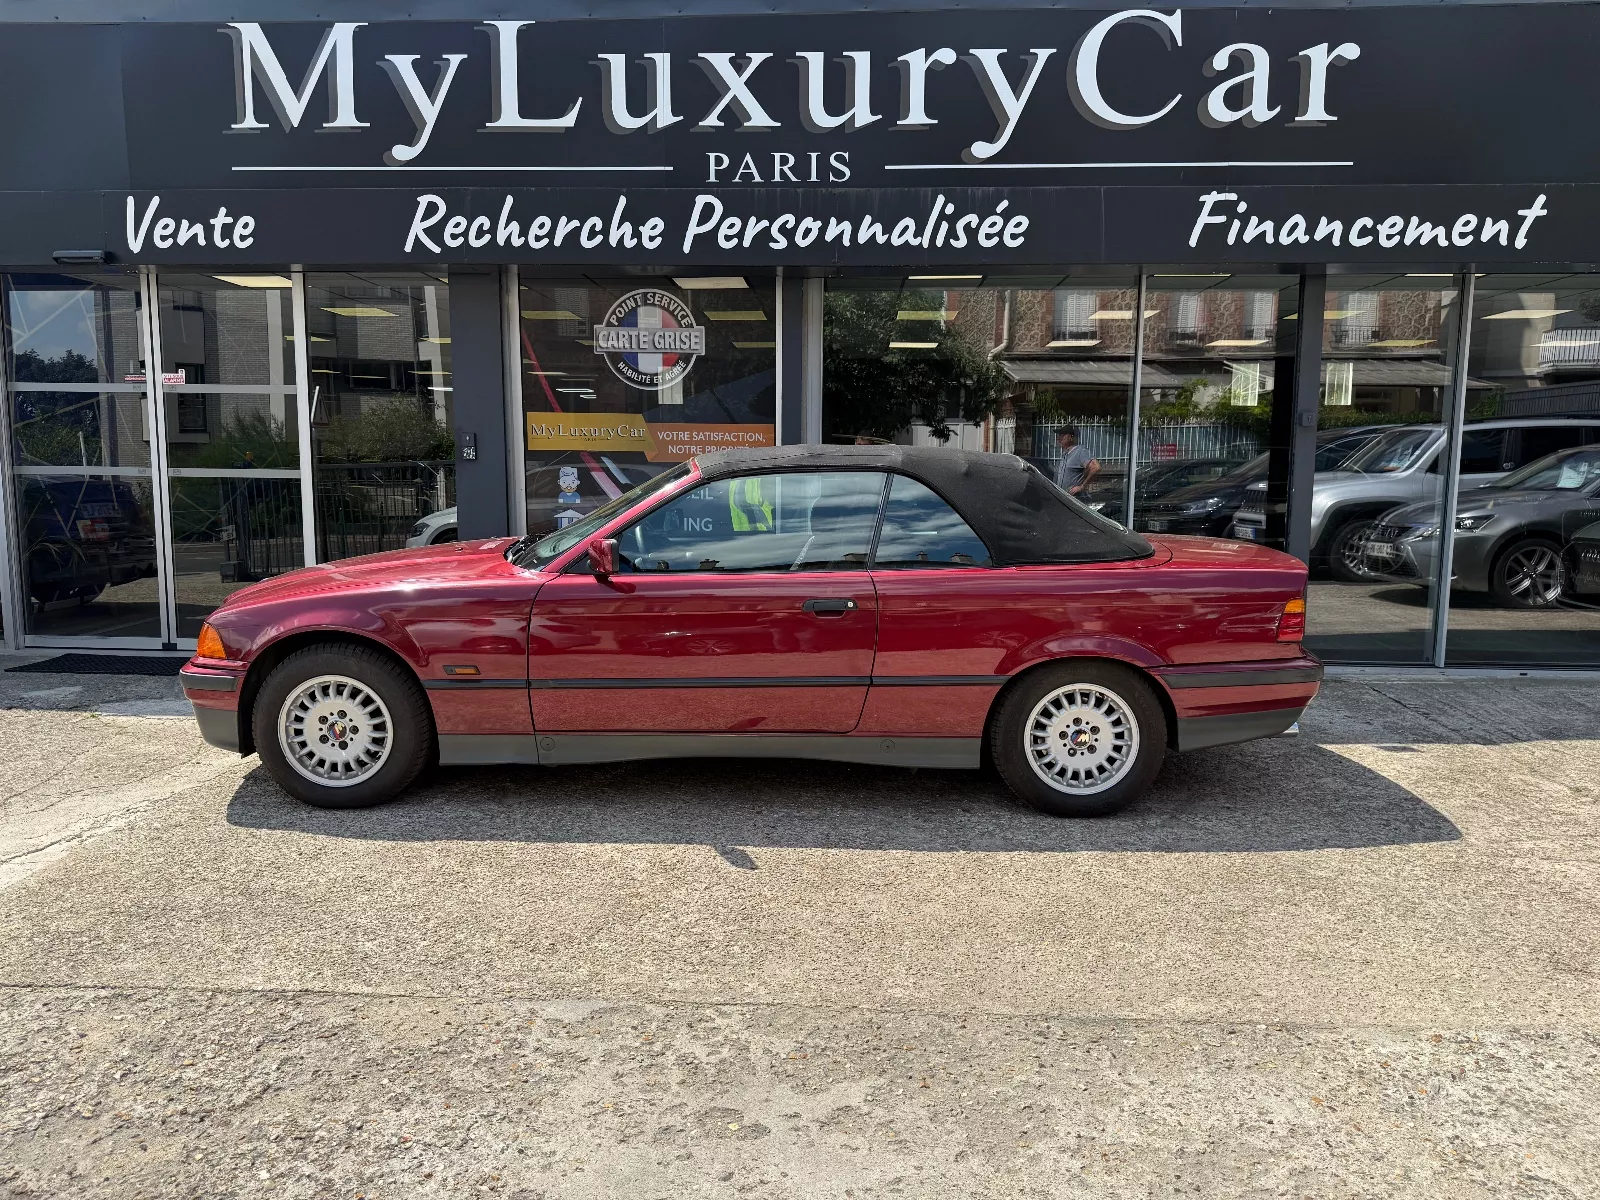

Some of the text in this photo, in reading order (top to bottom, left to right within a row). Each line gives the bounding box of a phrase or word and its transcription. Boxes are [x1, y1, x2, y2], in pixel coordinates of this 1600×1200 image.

[228, 9, 1361, 163] MyLuxuryCar
[705, 151, 851, 183] PARIS
[126, 195, 256, 254] Vente
[403, 193, 1030, 254] Recherche Personnalisée
[1188, 191, 1548, 250] Financement
[609, 292, 692, 328] POINT SERVICE
[598, 330, 700, 350] CARTE GRISE
[617, 359, 687, 384] HABILITÉ ET AGRÉÉ
[531, 423, 646, 440] MyLuxuryCar
[657, 431, 766, 443] VOTRE SATISFACTION,
[668, 443, 751, 455] NOTRE PRIO
[683, 517, 713, 532] ING
